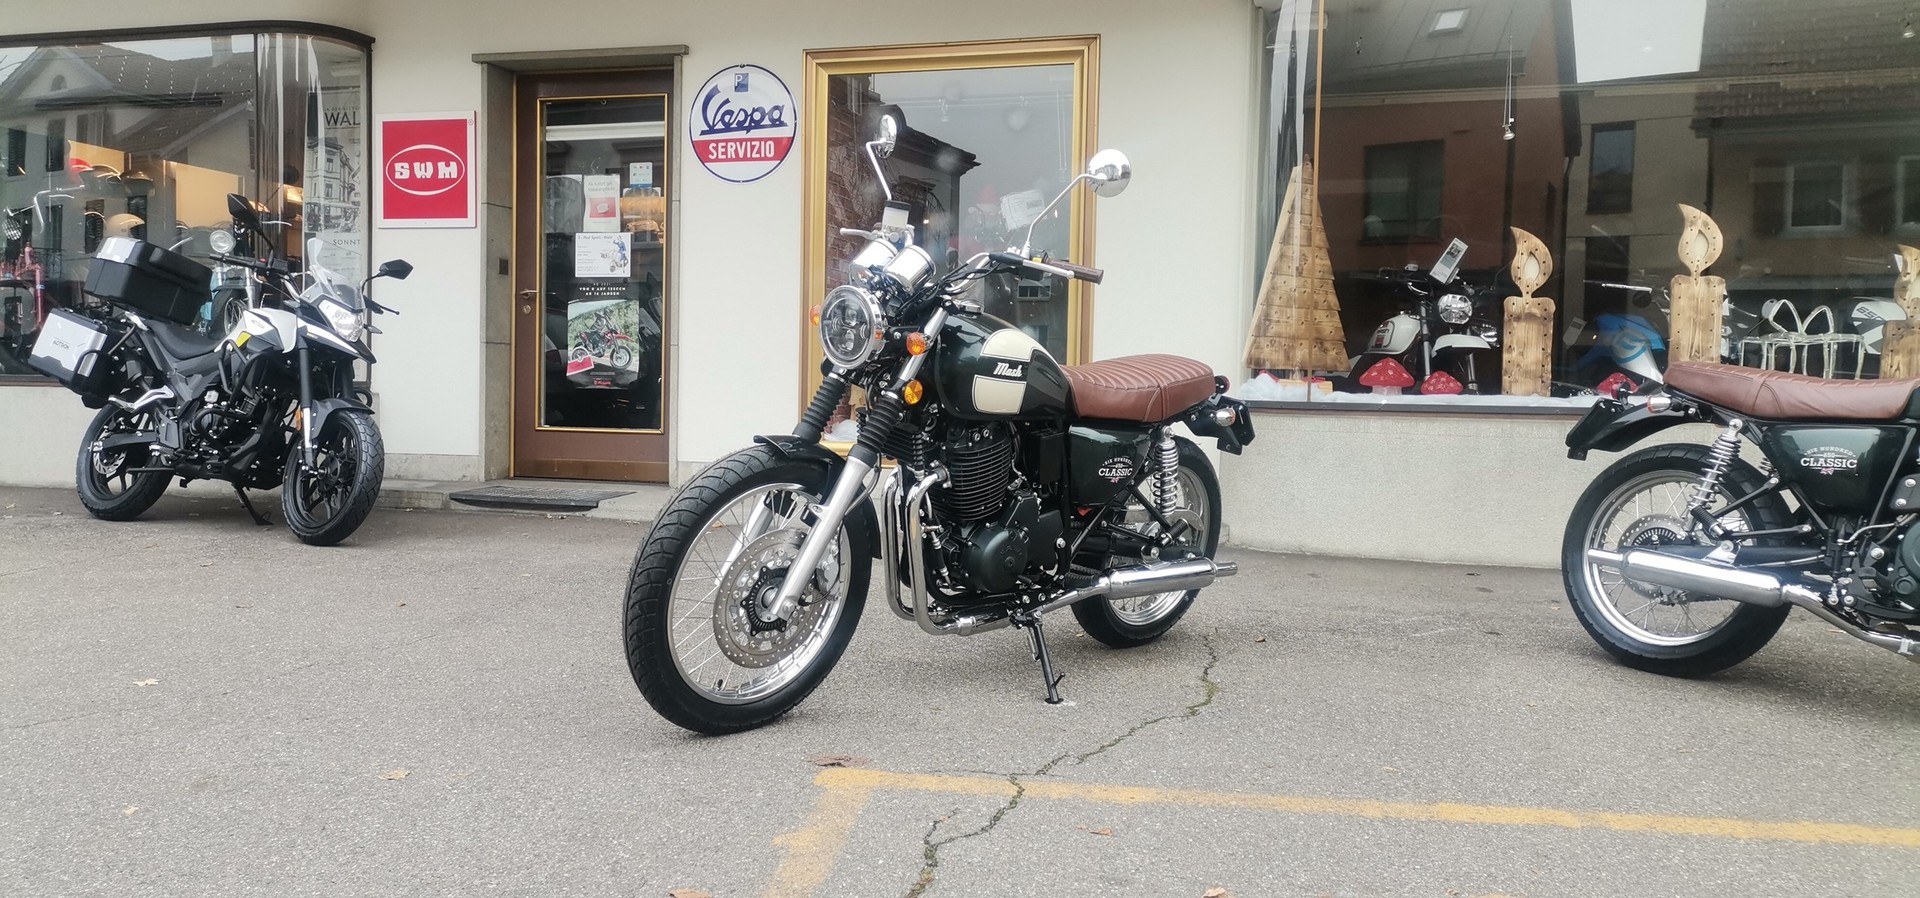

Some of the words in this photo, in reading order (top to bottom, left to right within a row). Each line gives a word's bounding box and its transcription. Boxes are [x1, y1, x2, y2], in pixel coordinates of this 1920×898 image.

[700, 84, 787, 134] Vespa
[324, 111, 361, 126] WAL
[708, 140, 775, 159] SERVIZIO
[394, 161, 458, 179] SWM
[993, 361, 1023, 378] Mash
[1819, 446, 1854, 456] HUNDRED
[1800, 457, 1858, 468] CLASSIC
[1099, 468, 1133, 476] CLASSIC
